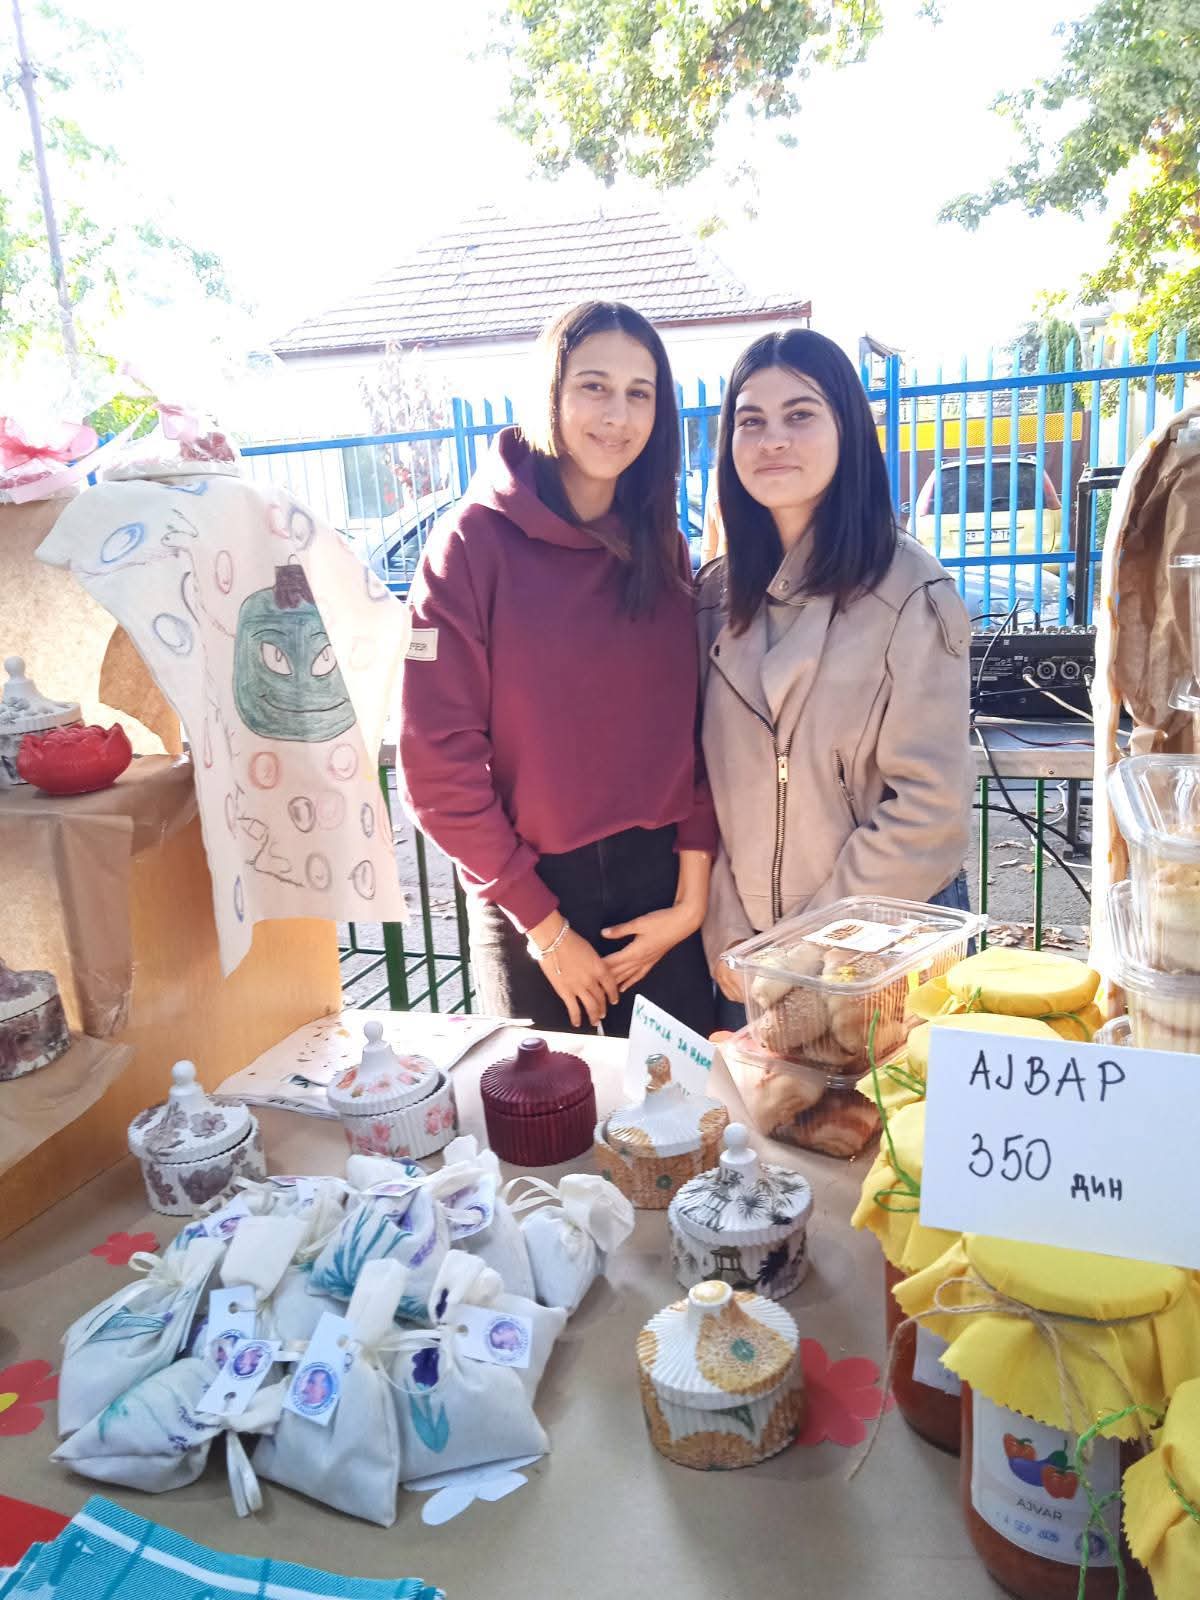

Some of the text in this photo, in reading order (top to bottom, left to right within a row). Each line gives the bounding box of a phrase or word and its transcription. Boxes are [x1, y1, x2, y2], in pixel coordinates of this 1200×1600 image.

[969, 1049, 1126, 1102] АЈВАР
[968, 1133, 1051, 1181] 350
[1016, 1498, 1063, 1521] AJVAR
